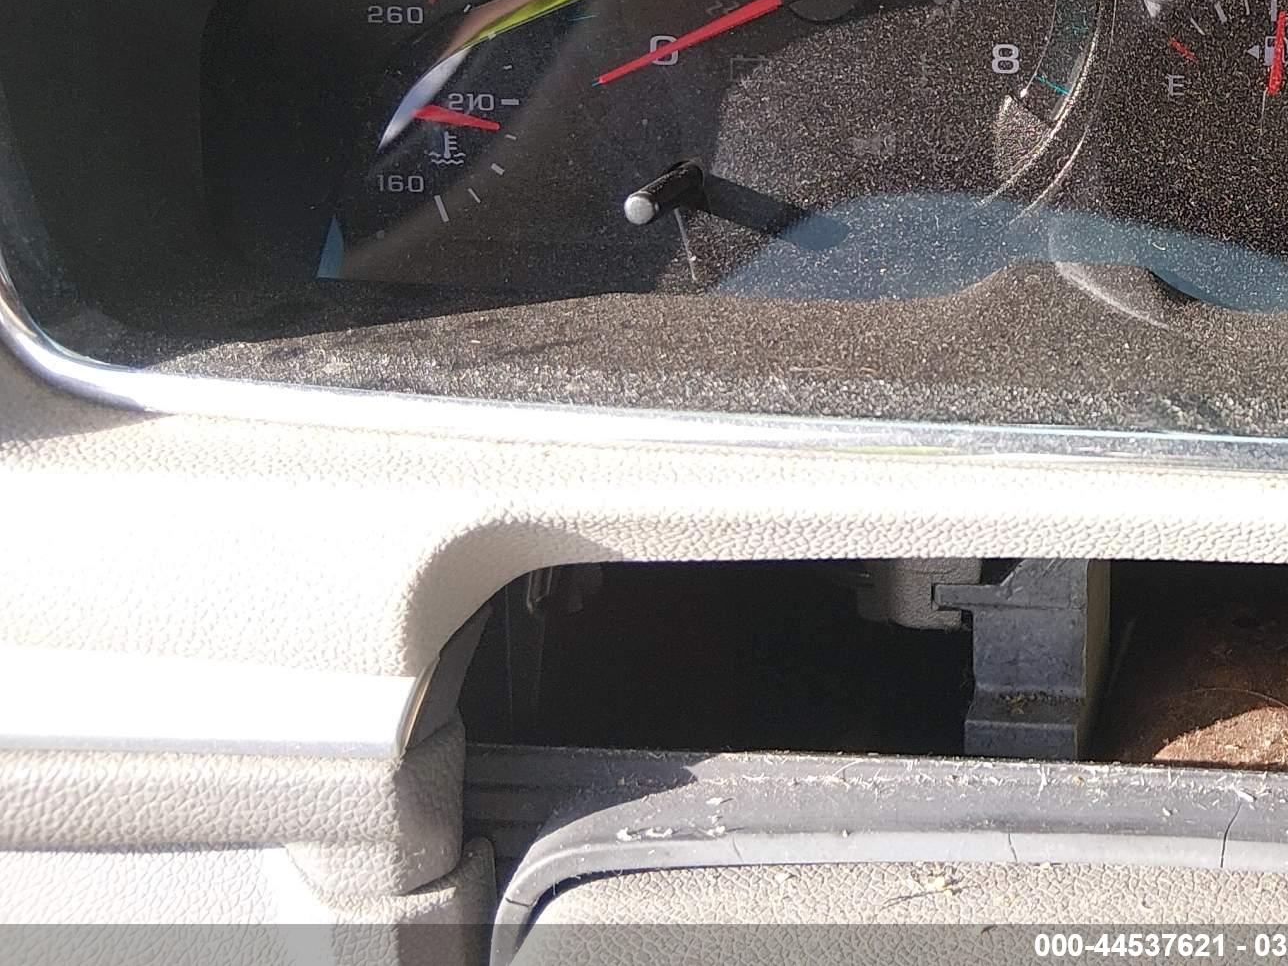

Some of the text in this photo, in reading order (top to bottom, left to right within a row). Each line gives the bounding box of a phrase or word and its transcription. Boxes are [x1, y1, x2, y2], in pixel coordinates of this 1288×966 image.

[367, 5, 423, 23] 260
[649, 35, 679, 66] 0
[991, 43, 1020, 75] 8
[1167, 74, 1184, 95] E
[449, 92, 495, 112] 210
[377, 174, 425, 194] 160
